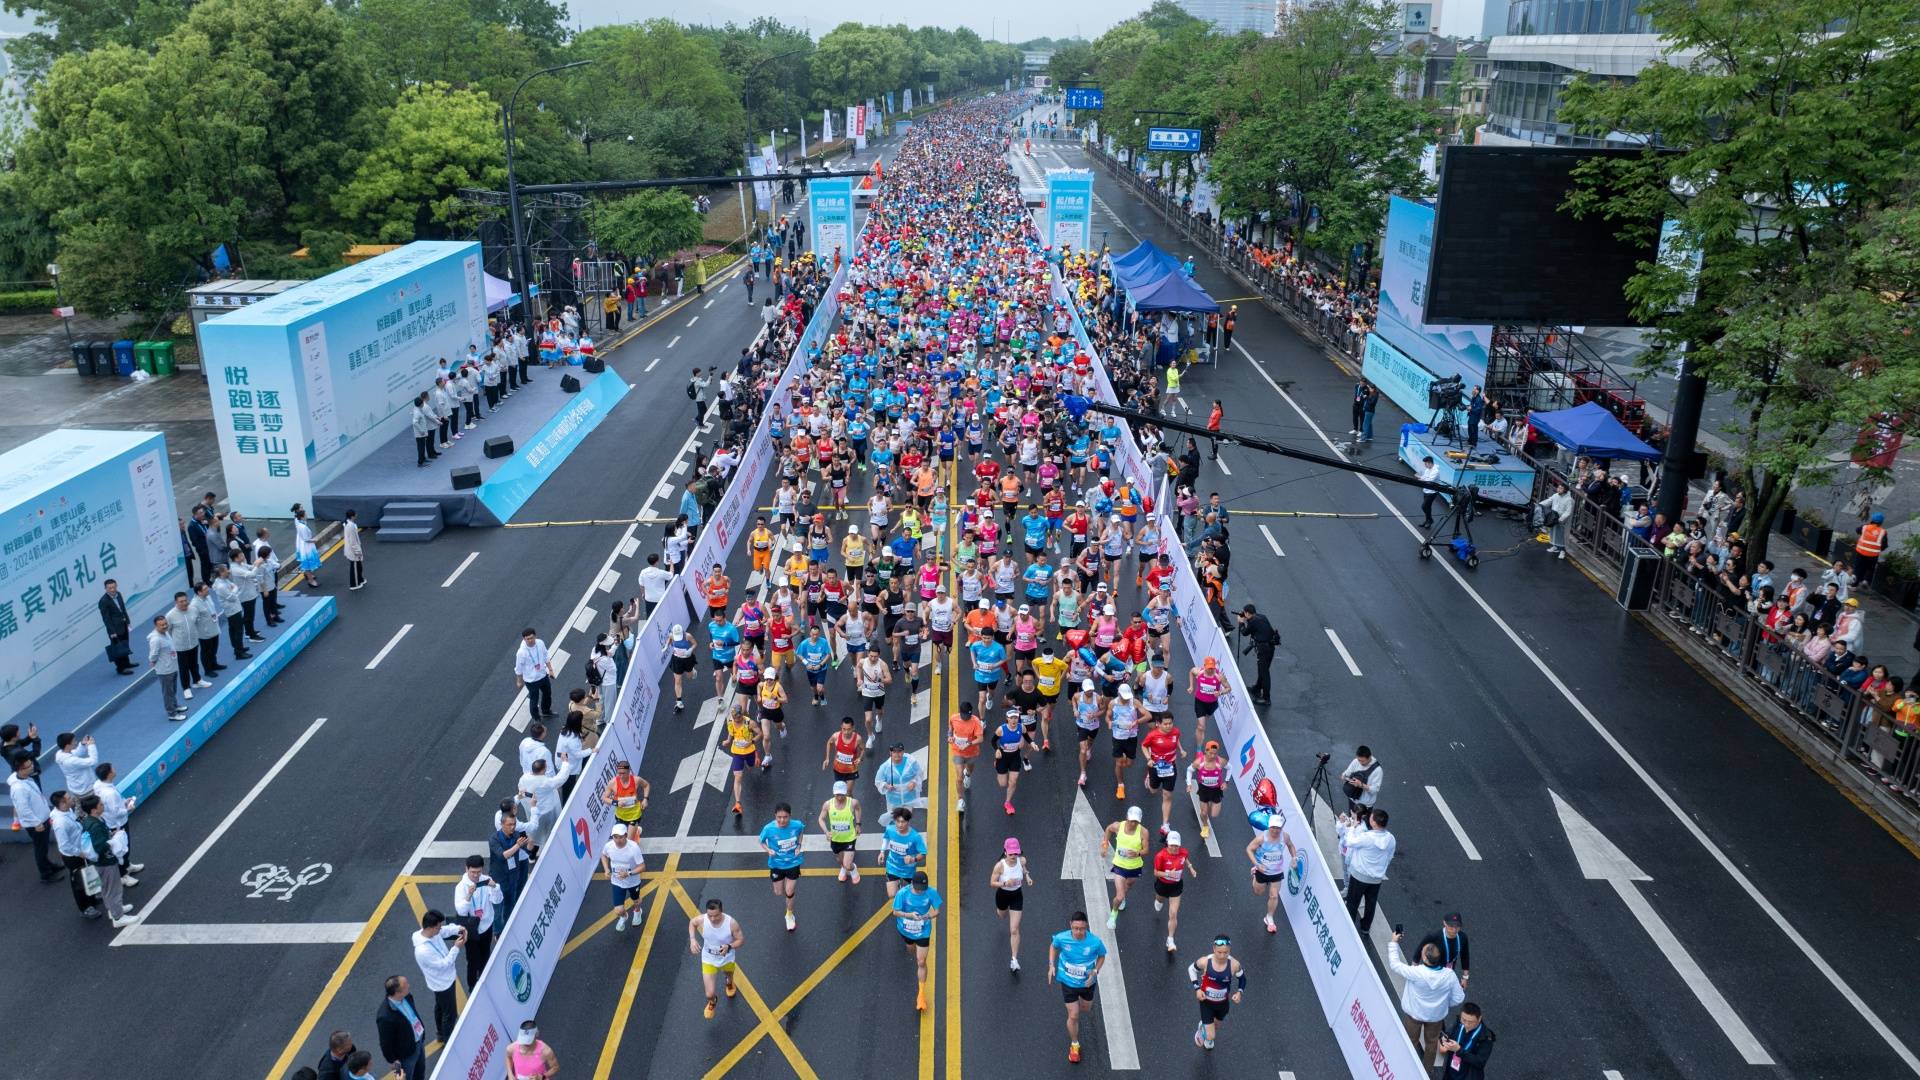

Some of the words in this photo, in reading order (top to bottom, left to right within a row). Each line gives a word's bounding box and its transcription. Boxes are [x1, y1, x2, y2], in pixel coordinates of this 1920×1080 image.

[224, 366, 259, 455] 悦跑富春
[256, 390, 291, 478] 逐梦山居
[50, 502, 86, 530] 逐梦山居
[1474, 473, 1512, 487] 摄影台
[0, 542, 117, 638] 嘉宾观礼台
[525, 873, 566, 960] 中国天然氧吧
[1303, 885, 1341, 976] 中国天然氧吧
